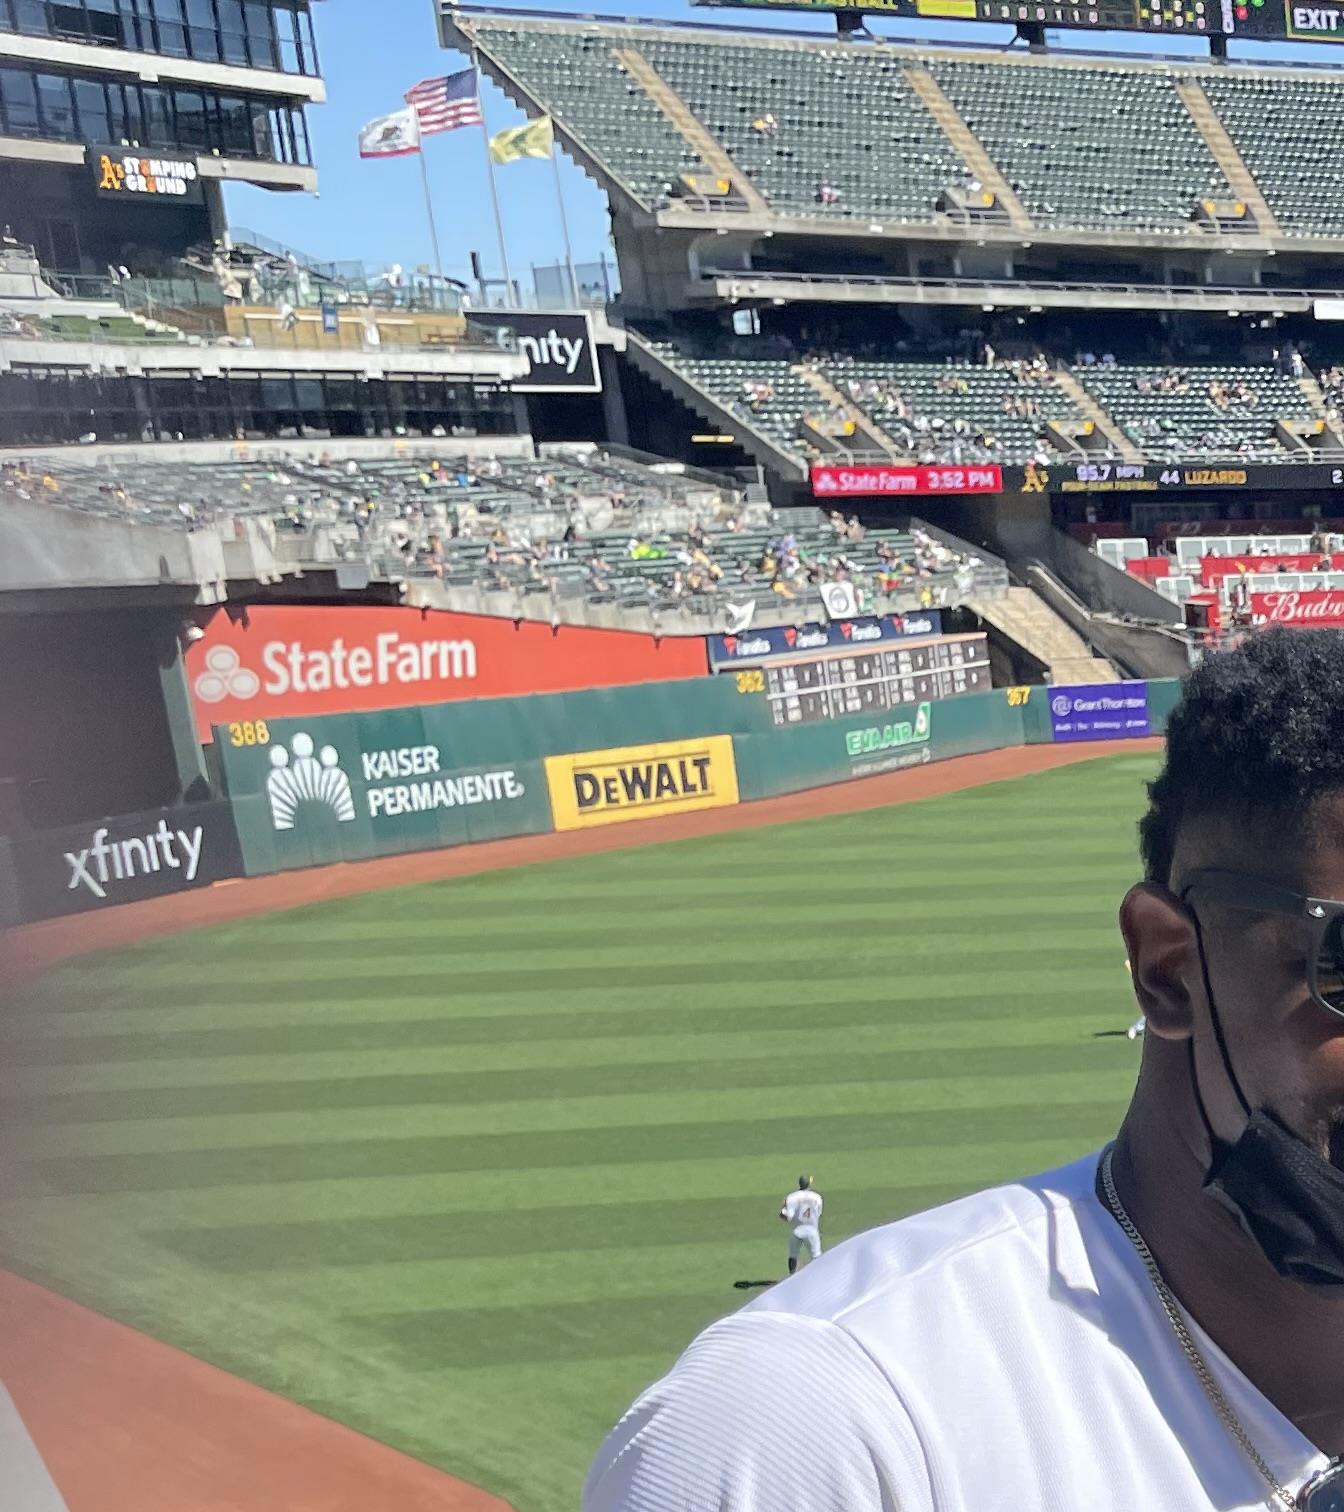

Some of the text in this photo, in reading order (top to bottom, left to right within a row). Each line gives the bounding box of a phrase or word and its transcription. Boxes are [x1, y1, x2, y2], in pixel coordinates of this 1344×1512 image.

[1293, 7, 1339, 31] EXIT
[968, 471, 994, 487] PM
[1159, 469, 1181, 485] 44
[1331, 468, 1344, 484] 2
[228, 719, 270, 747] 388
[361, 744, 440, 782] KAISER
[366, 769, 519, 819] PERMANENTE
[63, 819, 203, 897] xfinity
